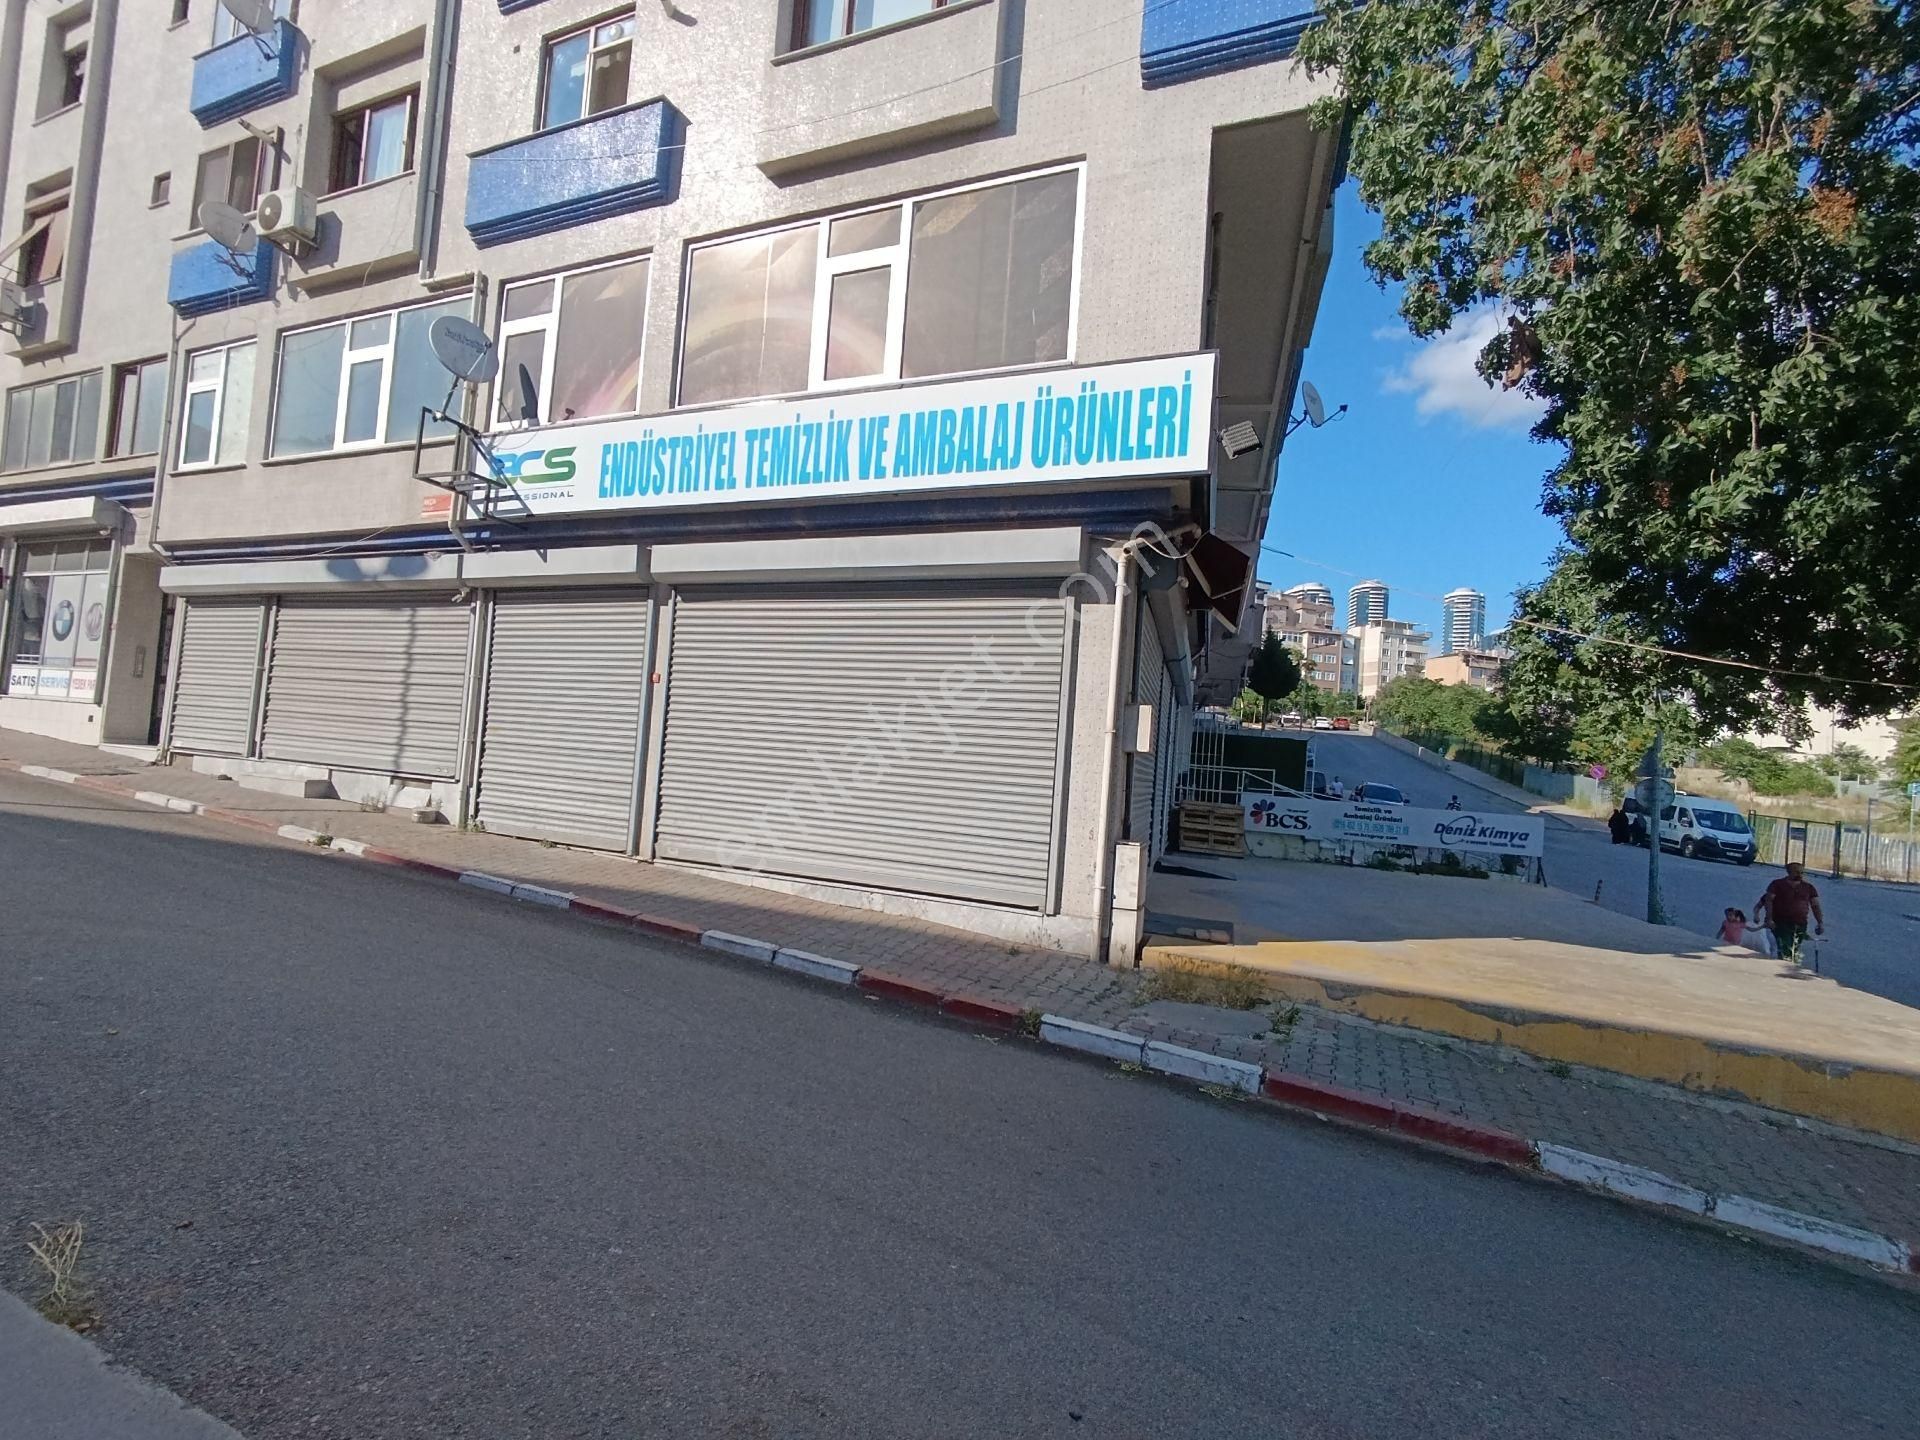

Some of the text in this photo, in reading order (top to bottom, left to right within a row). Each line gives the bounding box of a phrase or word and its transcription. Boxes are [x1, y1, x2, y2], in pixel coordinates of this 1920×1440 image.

[598, 370, 1192, 498] ENDÜSTRİYEL TEMİZLİK VE AMBALAJ ÜRÜNLERİ
[11, 675, 36, 689] SATIŞ
[1354, 805, 1382, 814] Temizlik
[1343, 812, 1403, 823] Ambalaj Ürünleri
[1433, 823, 1530, 843] Deniz Kimya
